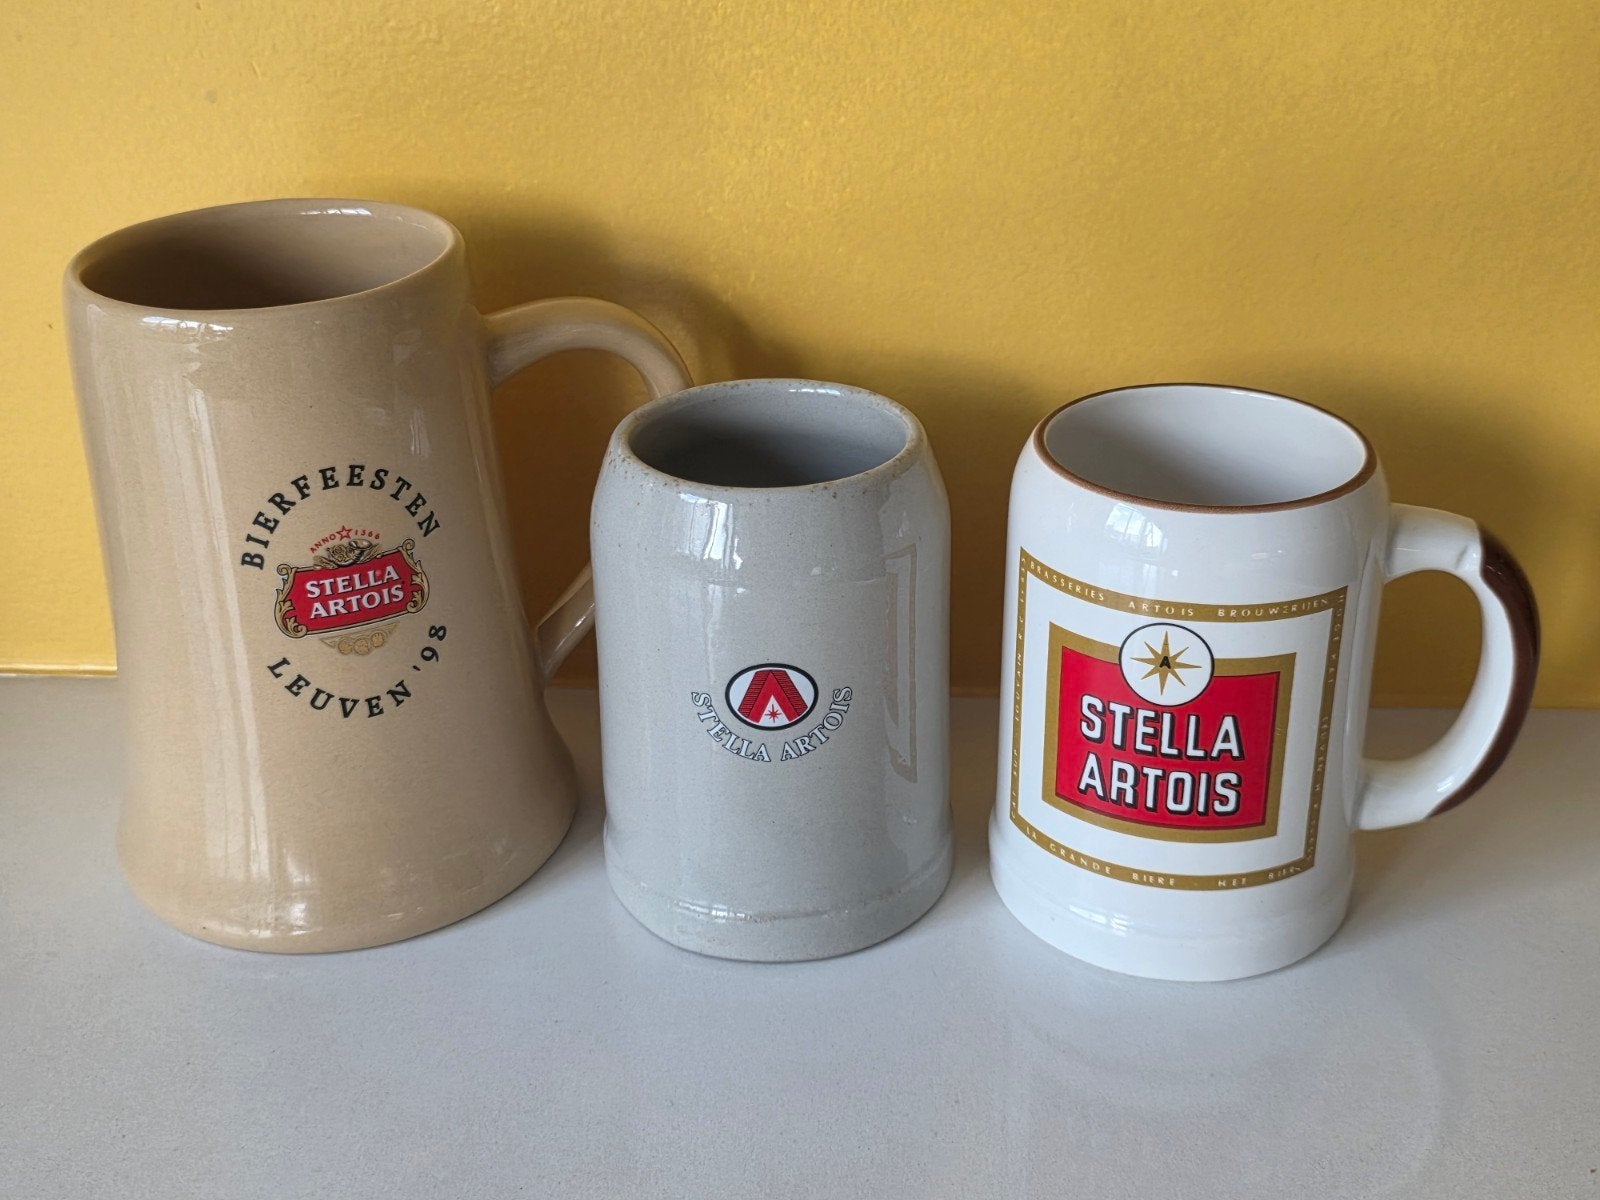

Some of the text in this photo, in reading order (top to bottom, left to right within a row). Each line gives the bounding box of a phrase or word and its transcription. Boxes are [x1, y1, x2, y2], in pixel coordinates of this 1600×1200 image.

[241, 464, 441, 571] BIERFEESTEN
[309, 533, 336, 554] ANNO
[305, 565, 400, 599] STELLA
[310, 585, 405, 620] ARTOIS
[1029, 560, 1105, 601] BRASSERIES
[1128, 600, 1194, 616] ARTOIS
[267, 657, 412, 719] LEUVEN
[691, 686, 854, 763] STELLA ARTOIS
[1080, 694, 1245, 761] STELLA
[1078, 752, 1242, 814] ARTOIS
[1049, 843, 1111, 875] GRANDE
